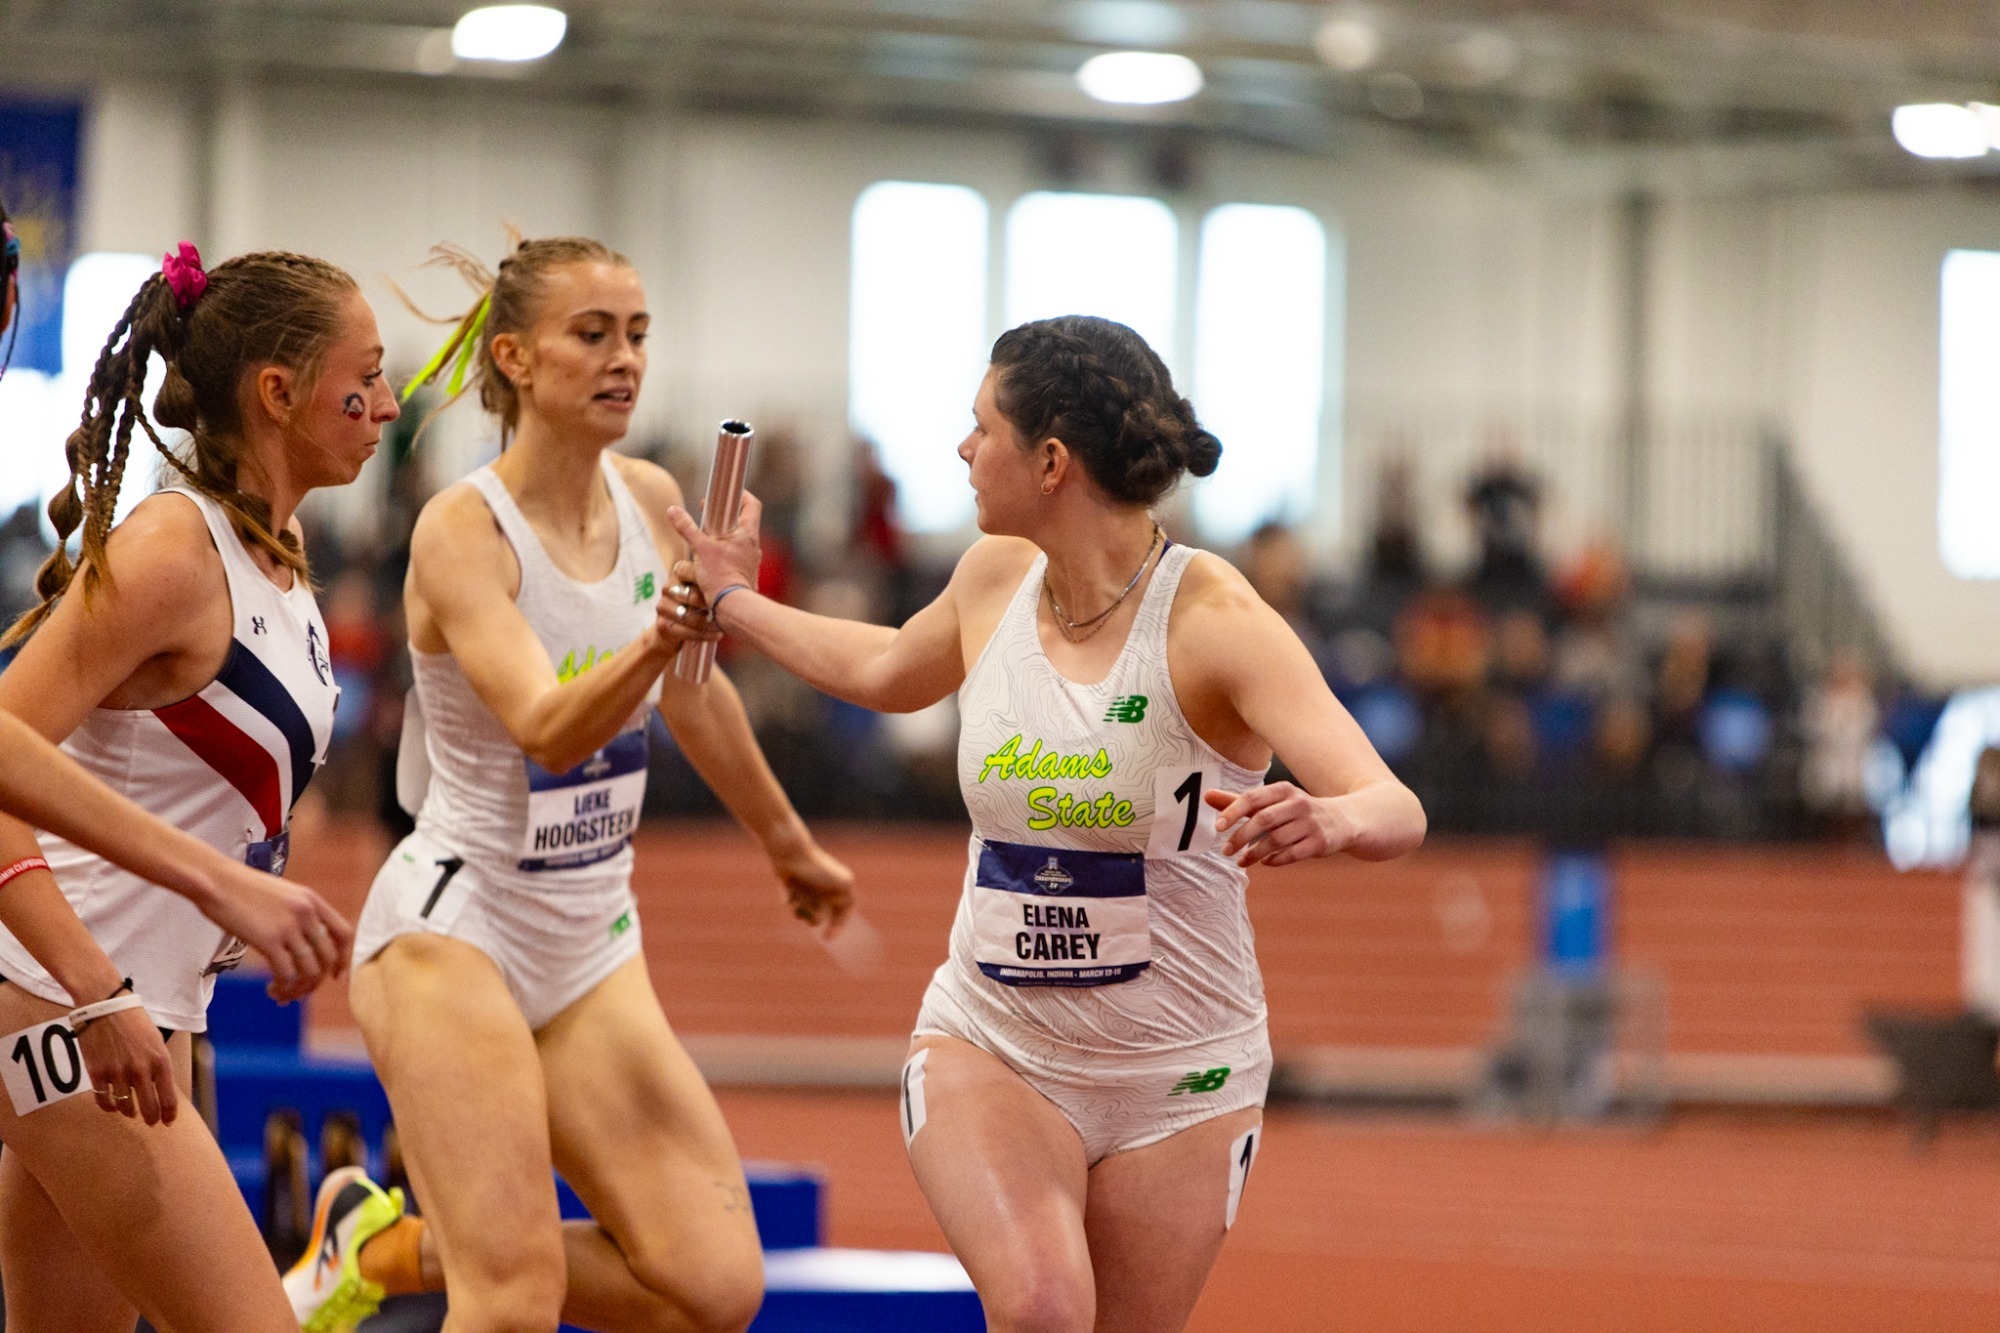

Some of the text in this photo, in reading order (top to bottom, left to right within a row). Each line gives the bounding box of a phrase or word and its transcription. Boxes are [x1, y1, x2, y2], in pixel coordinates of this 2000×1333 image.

[978, 733, 1112, 783] Adams
[535, 806, 635, 851] HOOGSTEEN
[1028, 786, 1135, 830] State
[1173, 771, 1203, 852] 1
[1023, 904, 1090, 928] ELENA
[1016, 931, 1101, 960] CAREY
[999, 968, 1046, 979] INDIANAPOLIS,
[1047, 969, 1074, 979] INDIANA
[1079, 969, 1104, 979] MARCH
[11, 1023, 81, 1104] 10
